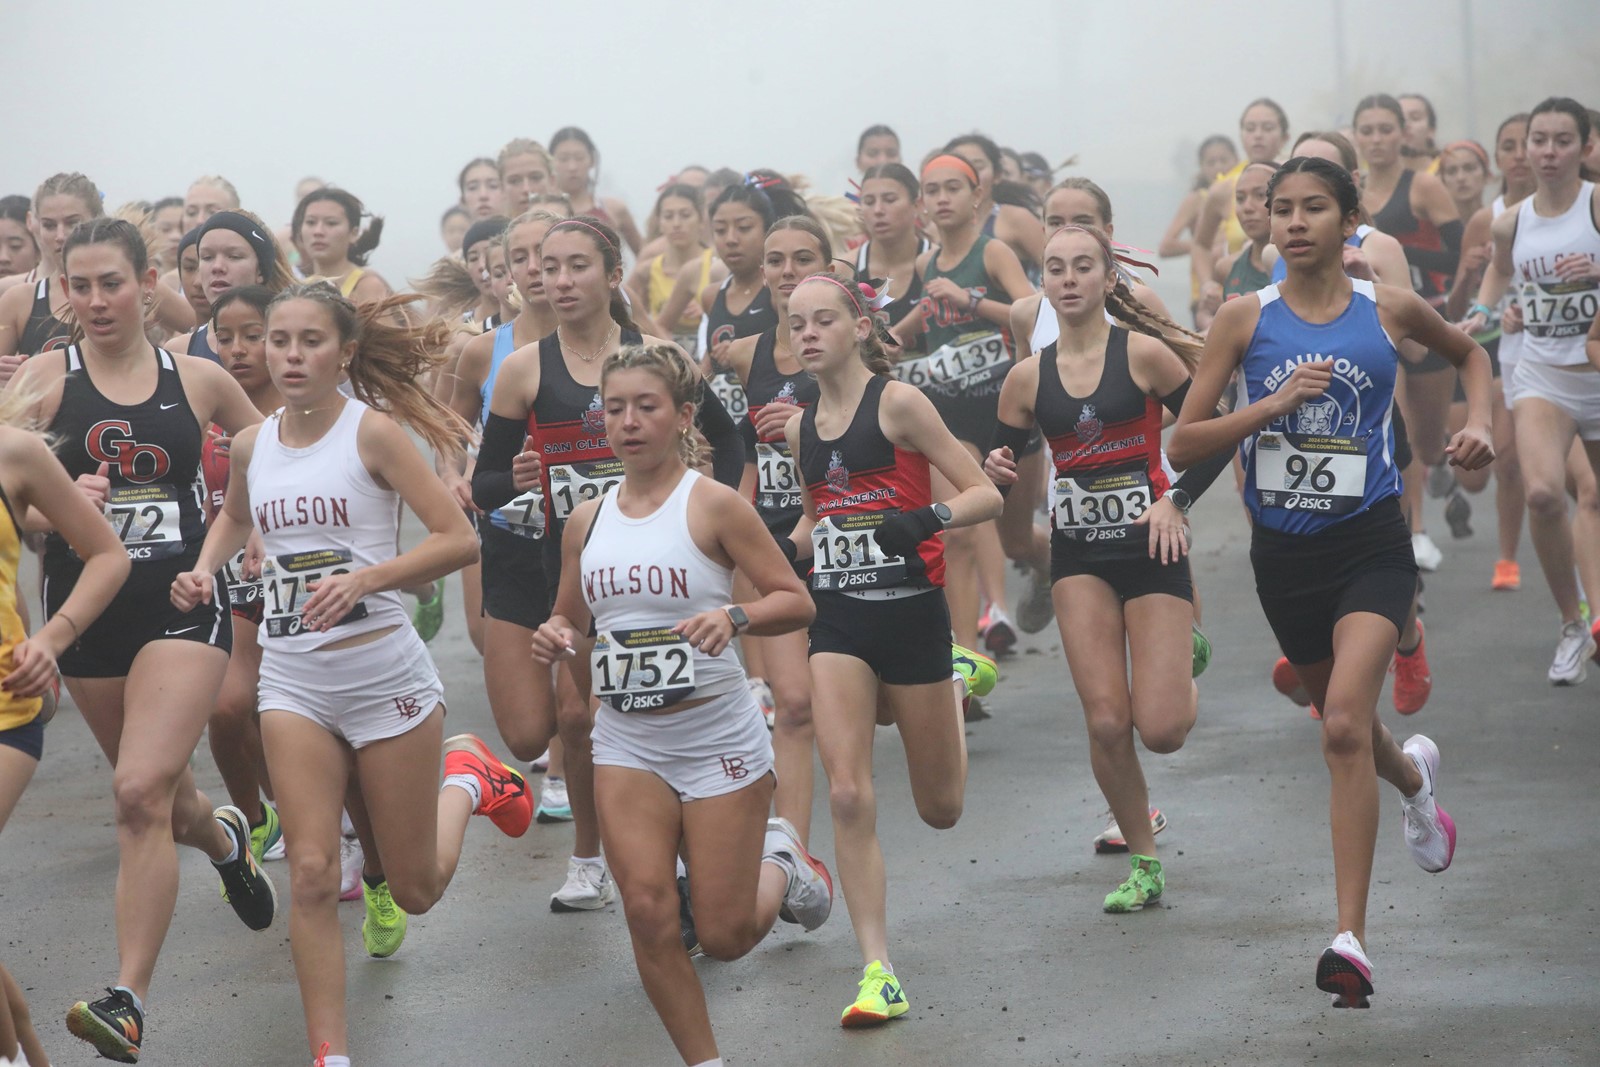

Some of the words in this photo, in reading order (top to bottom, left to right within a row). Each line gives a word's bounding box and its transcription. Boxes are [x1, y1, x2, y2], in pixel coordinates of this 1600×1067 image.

[1520, 253, 1594, 282] WIL
[1527, 294, 1598, 322] 1760
[935, 340, 1002, 380] 1139
[85, 419, 171, 484] GO
[543, 442, 573, 454] SAN
[1075, 434, 1146, 458] CLEMENTE
[1286, 454, 1336, 493] 96
[557, 480, 620, 516] 13
[828, 487, 896, 510] CLEMENTE
[1060, 491, 1147, 526] 1303
[1300, 496, 1332, 510] asics
[111, 505, 166, 542] 72
[255, 496, 350, 535] WILSON
[1098, 528, 1126, 540] asics
[128, 547, 152, 558] sics
[818, 533, 901, 570] 131
[584, 564, 690, 604] WILSON
[849, 572, 878, 585] asics
[596, 648, 690, 691] 1752
[633, 694, 664, 708] asics
